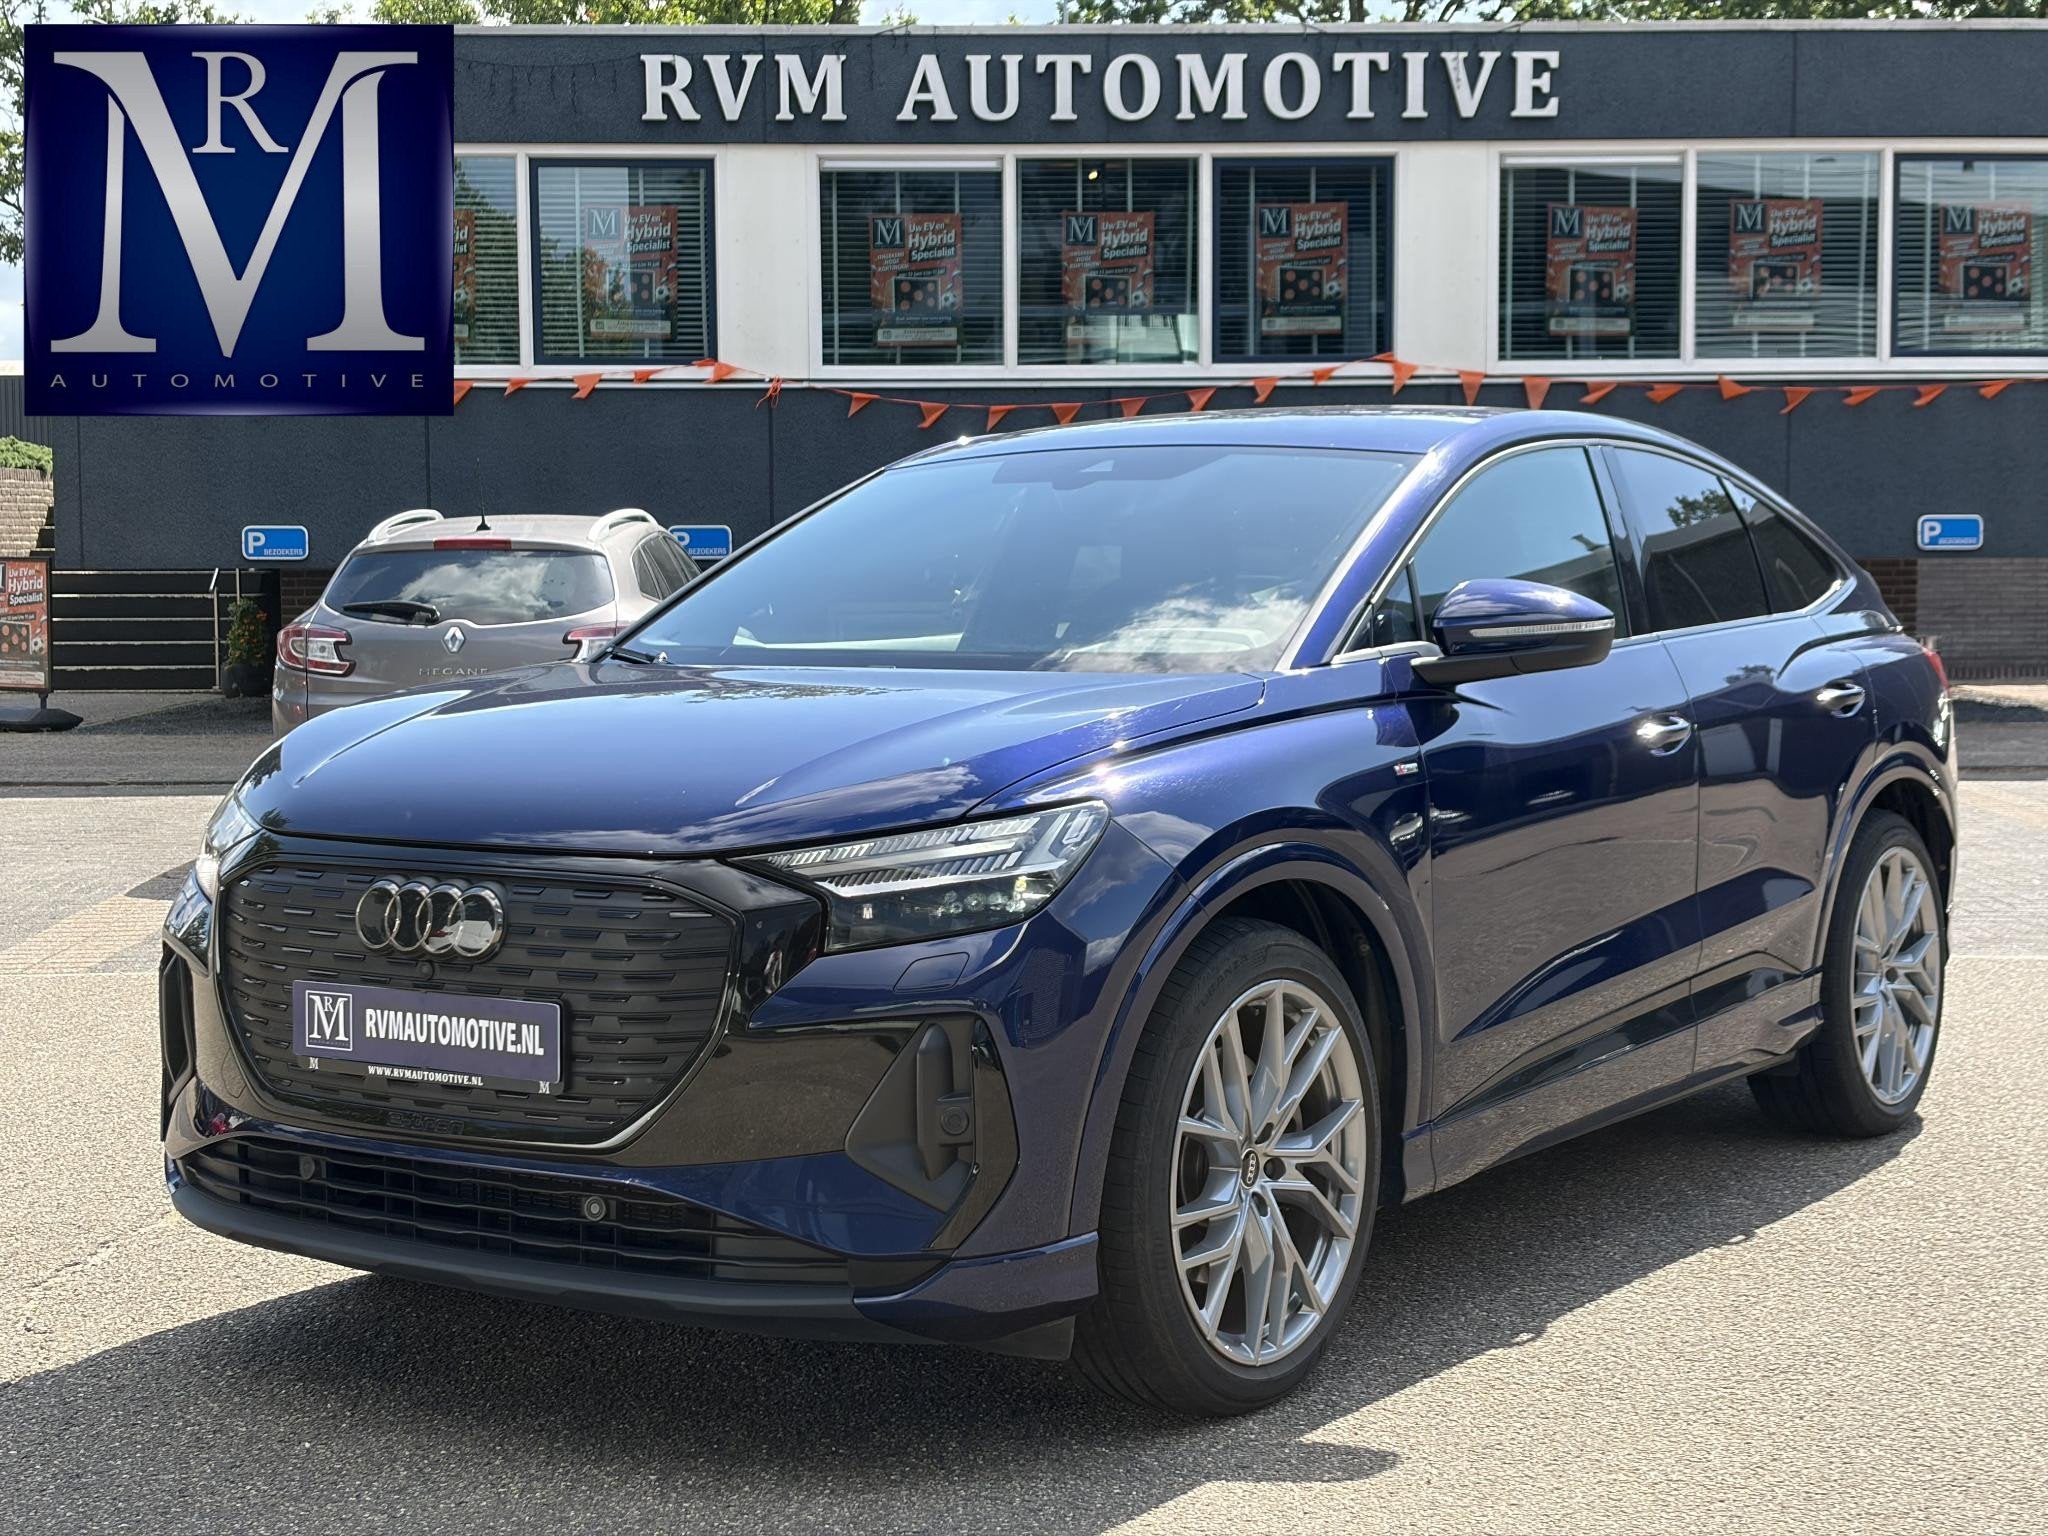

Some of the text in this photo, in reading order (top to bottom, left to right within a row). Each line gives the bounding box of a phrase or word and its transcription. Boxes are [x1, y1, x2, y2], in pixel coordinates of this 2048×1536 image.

[640, 50, 1561, 123] RVM AUTOMOTIVE
[624, 222, 672, 241] Hybrid
[1295, 219, 1342, 239] Hybrid
[1586, 223, 1632, 241] Hybrid
[1769, 216, 1817, 236] Hybrid
[1979, 217, 2026, 236] Hybrid
[626, 240, 671, 253] Specialist
[908, 229, 956, 250] Hybrid
[1100, 228, 1148, 248] Hybrid
[1297, 237, 1341, 250] Specialist
[911, 247, 955, 261] Specialist
[1103, 246, 1147, 260] Specialist
[248, 531, 266, 554] P
[688, 547, 728, 555] BEZOEKERS
[8, 576, 44, 595] Hybrid
[9, 592, 43, 606] Specialist
[365, 1008, 545, 1056] RVMAUTOMOTIVE.NL
[367, 1065, 484, 1086] WWW.RVMAUTOMOTIVE.NL
